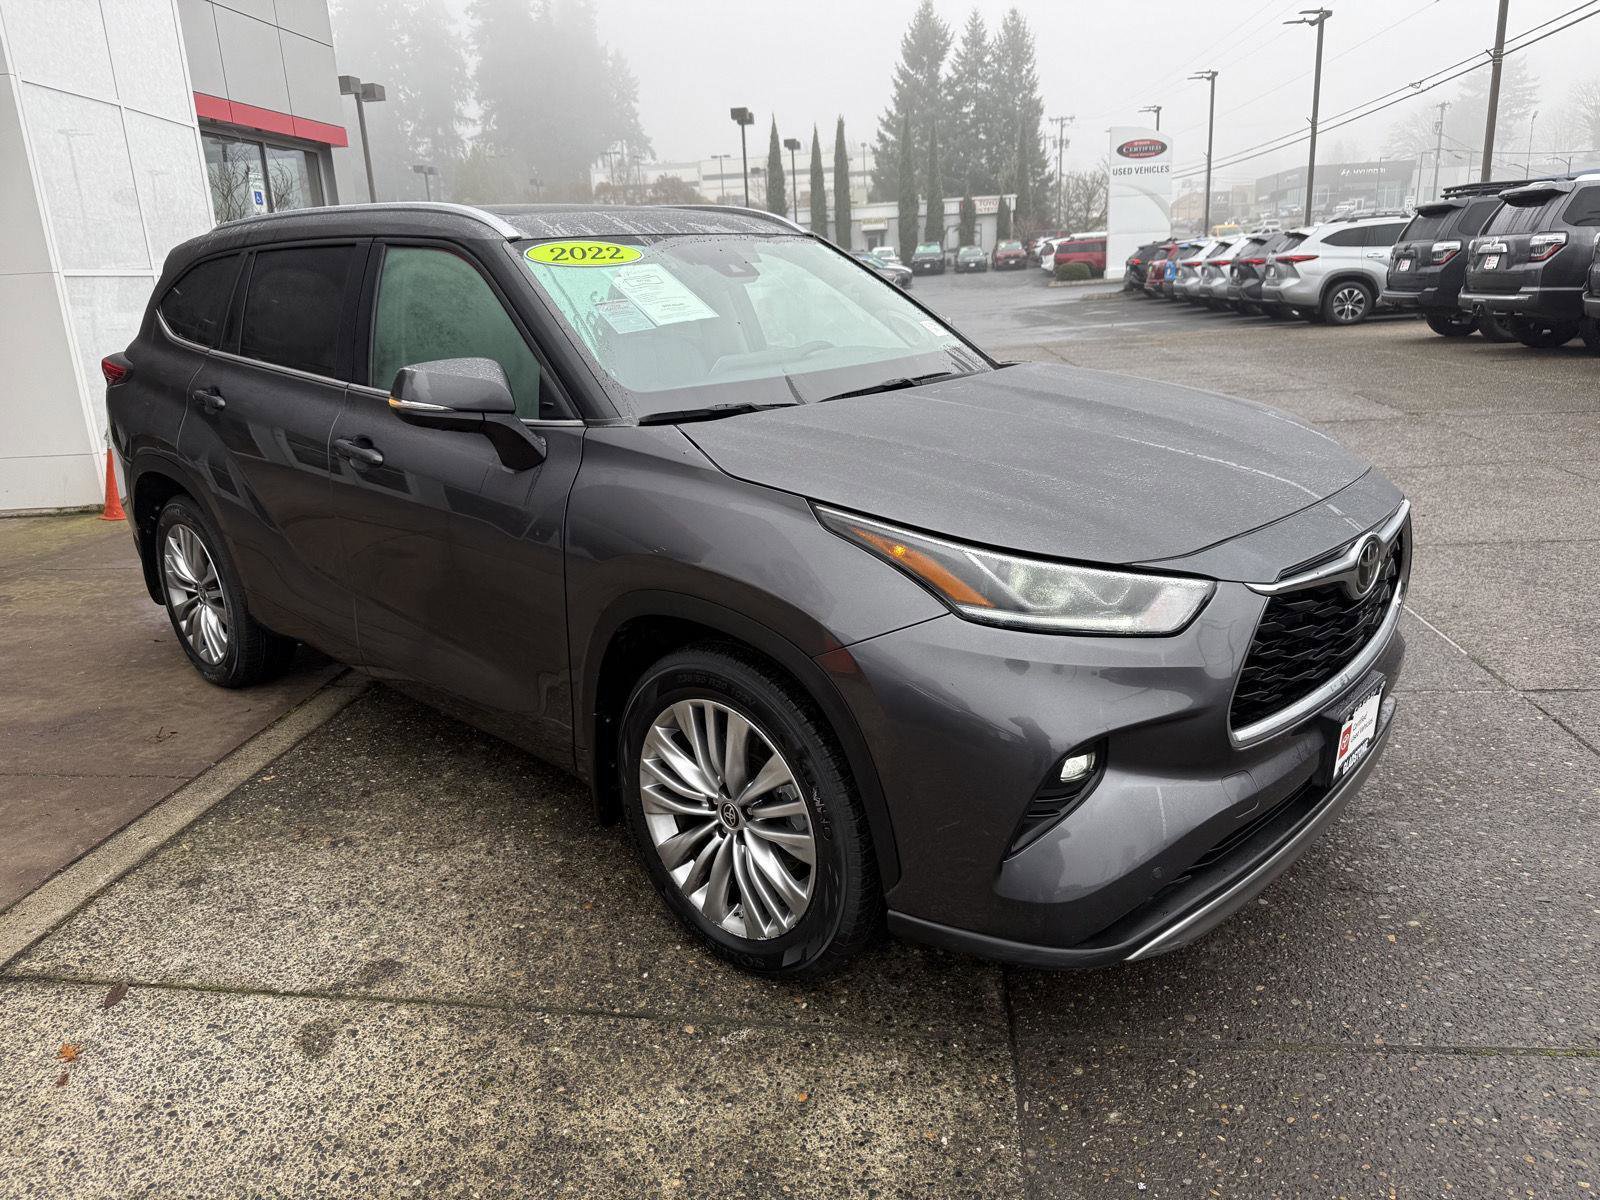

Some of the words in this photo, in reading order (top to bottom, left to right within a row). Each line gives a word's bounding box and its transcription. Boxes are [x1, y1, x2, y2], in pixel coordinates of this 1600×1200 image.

[1122, 144, 1164, 153] CERTIFIED
[1134, 165, 1170, 174] VEHICLES
[550, 246, 624, 261] 2022
